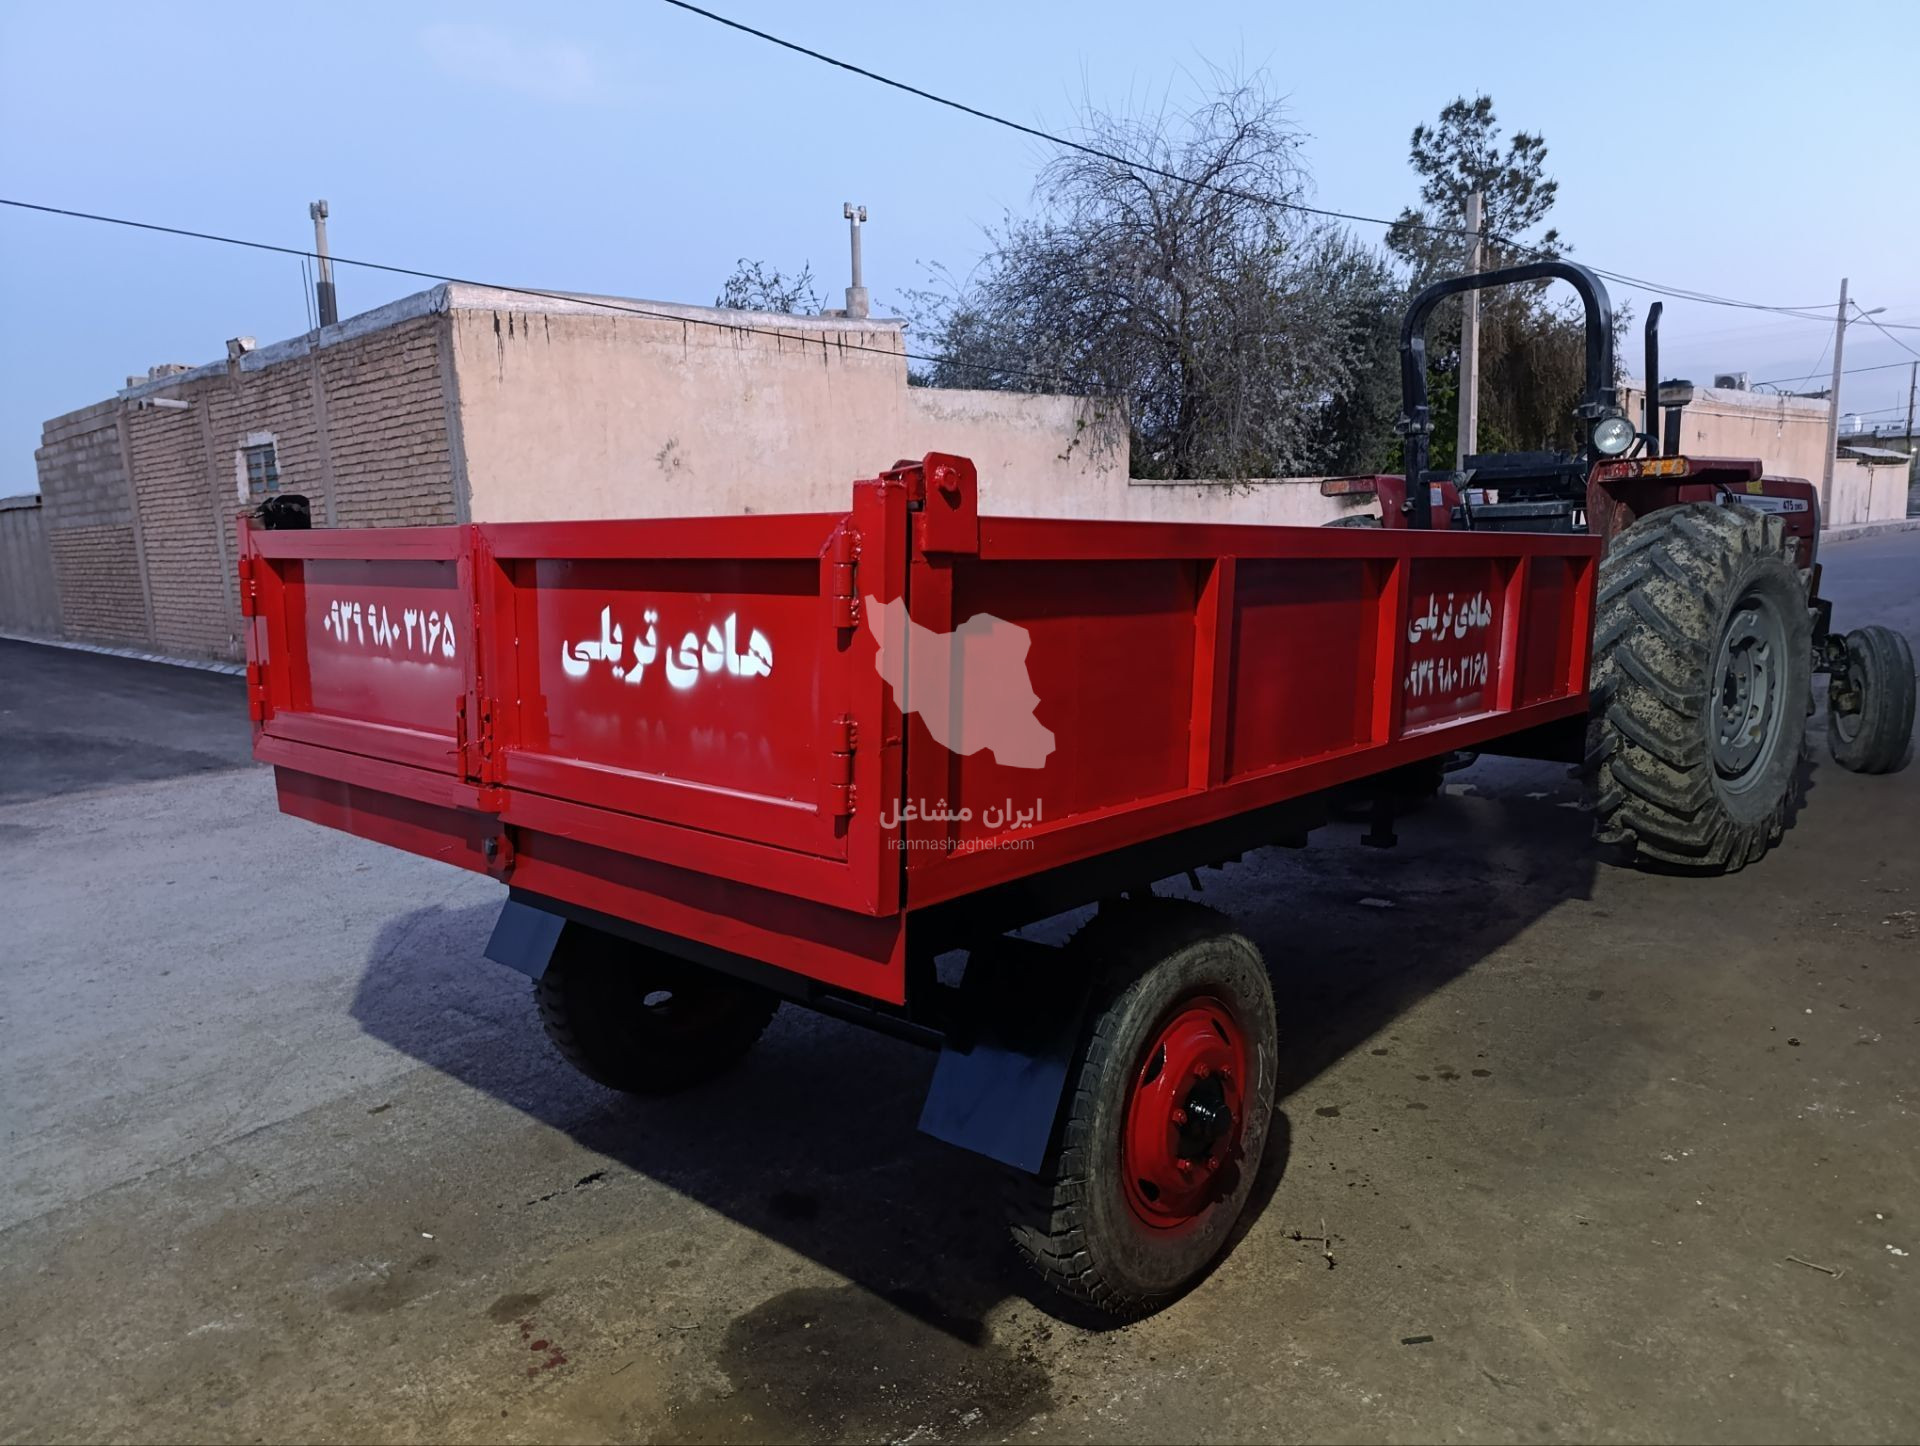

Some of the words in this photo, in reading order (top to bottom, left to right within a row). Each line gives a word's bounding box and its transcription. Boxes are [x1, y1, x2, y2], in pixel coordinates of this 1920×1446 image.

[1783, 500, 1793, 511] 475
[323, 599, 365, 646] ۰۹۳۹
[367, 603, 401, 650] ۹۸۰
[403, 607, 456, 658] ۳۱۶۵
[1407, 592, 1454, 643] تریلی
[1454, 590, 1492, 639] هادی
[561, 603, 659, 684] تریلی
[665, 611, 774, 689] هادی
